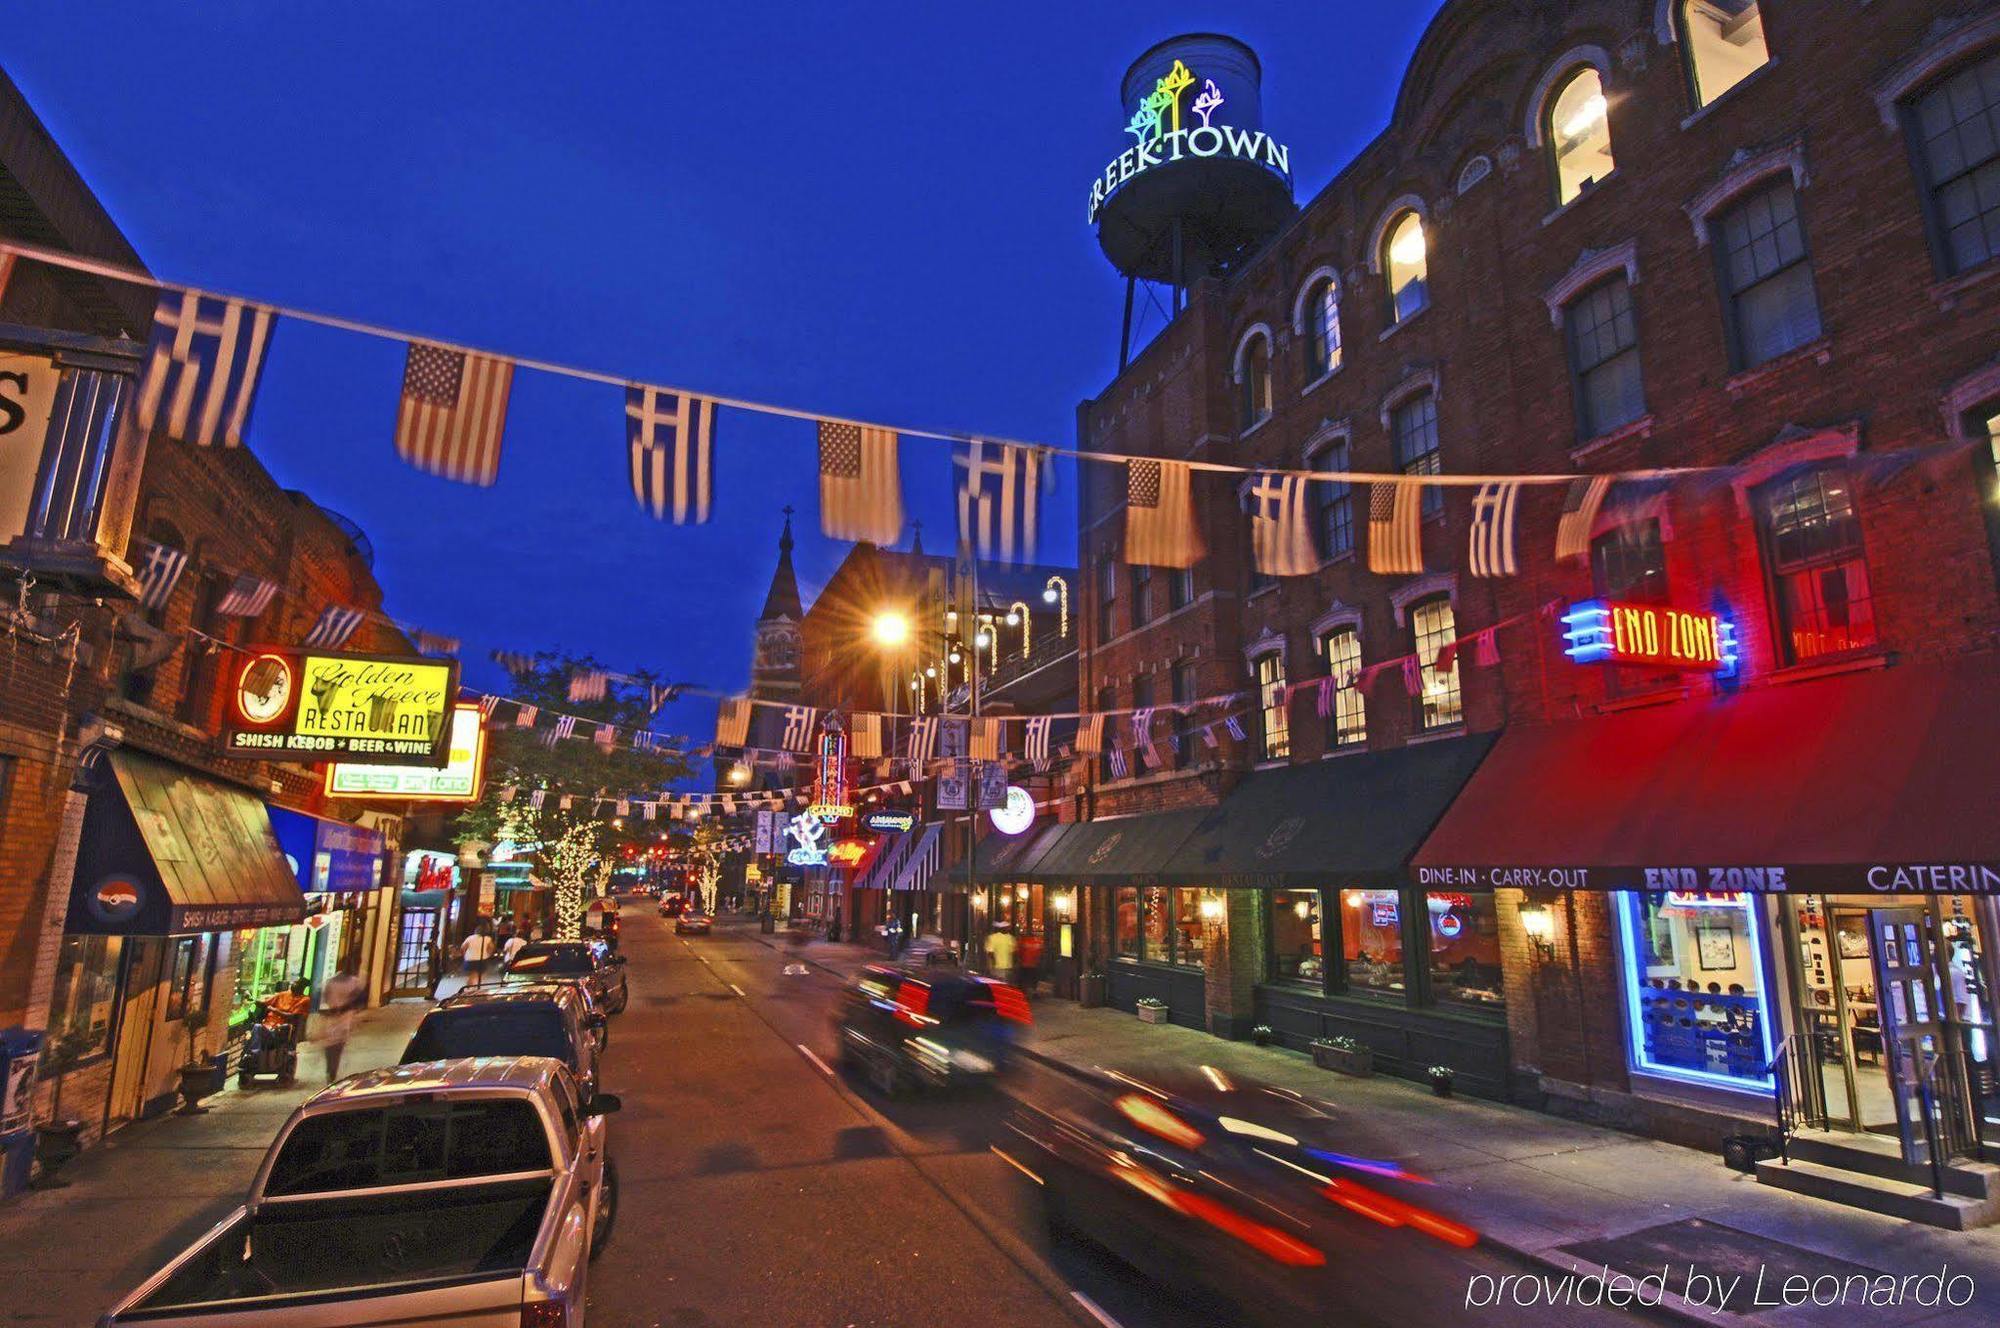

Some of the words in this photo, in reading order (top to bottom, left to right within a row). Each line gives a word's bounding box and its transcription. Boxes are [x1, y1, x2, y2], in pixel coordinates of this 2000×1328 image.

[1613, 607, 1659, 656] END
[1666, 612, 1721, 661] ZONE
[312, 663, 414, 689] Golden
[351, 686, 441, 708] Fleece
[236, 733, 283, 749] SHISH
[287, 735, 335, 751] KEBOB
[1419, 868, 1476, 885] DINE-IN
[1491, 868, 1588, 888] CARRY-OUT
[1644, 867, 1698, 890] END
[1708, 867, 1787, 892] ZONE
